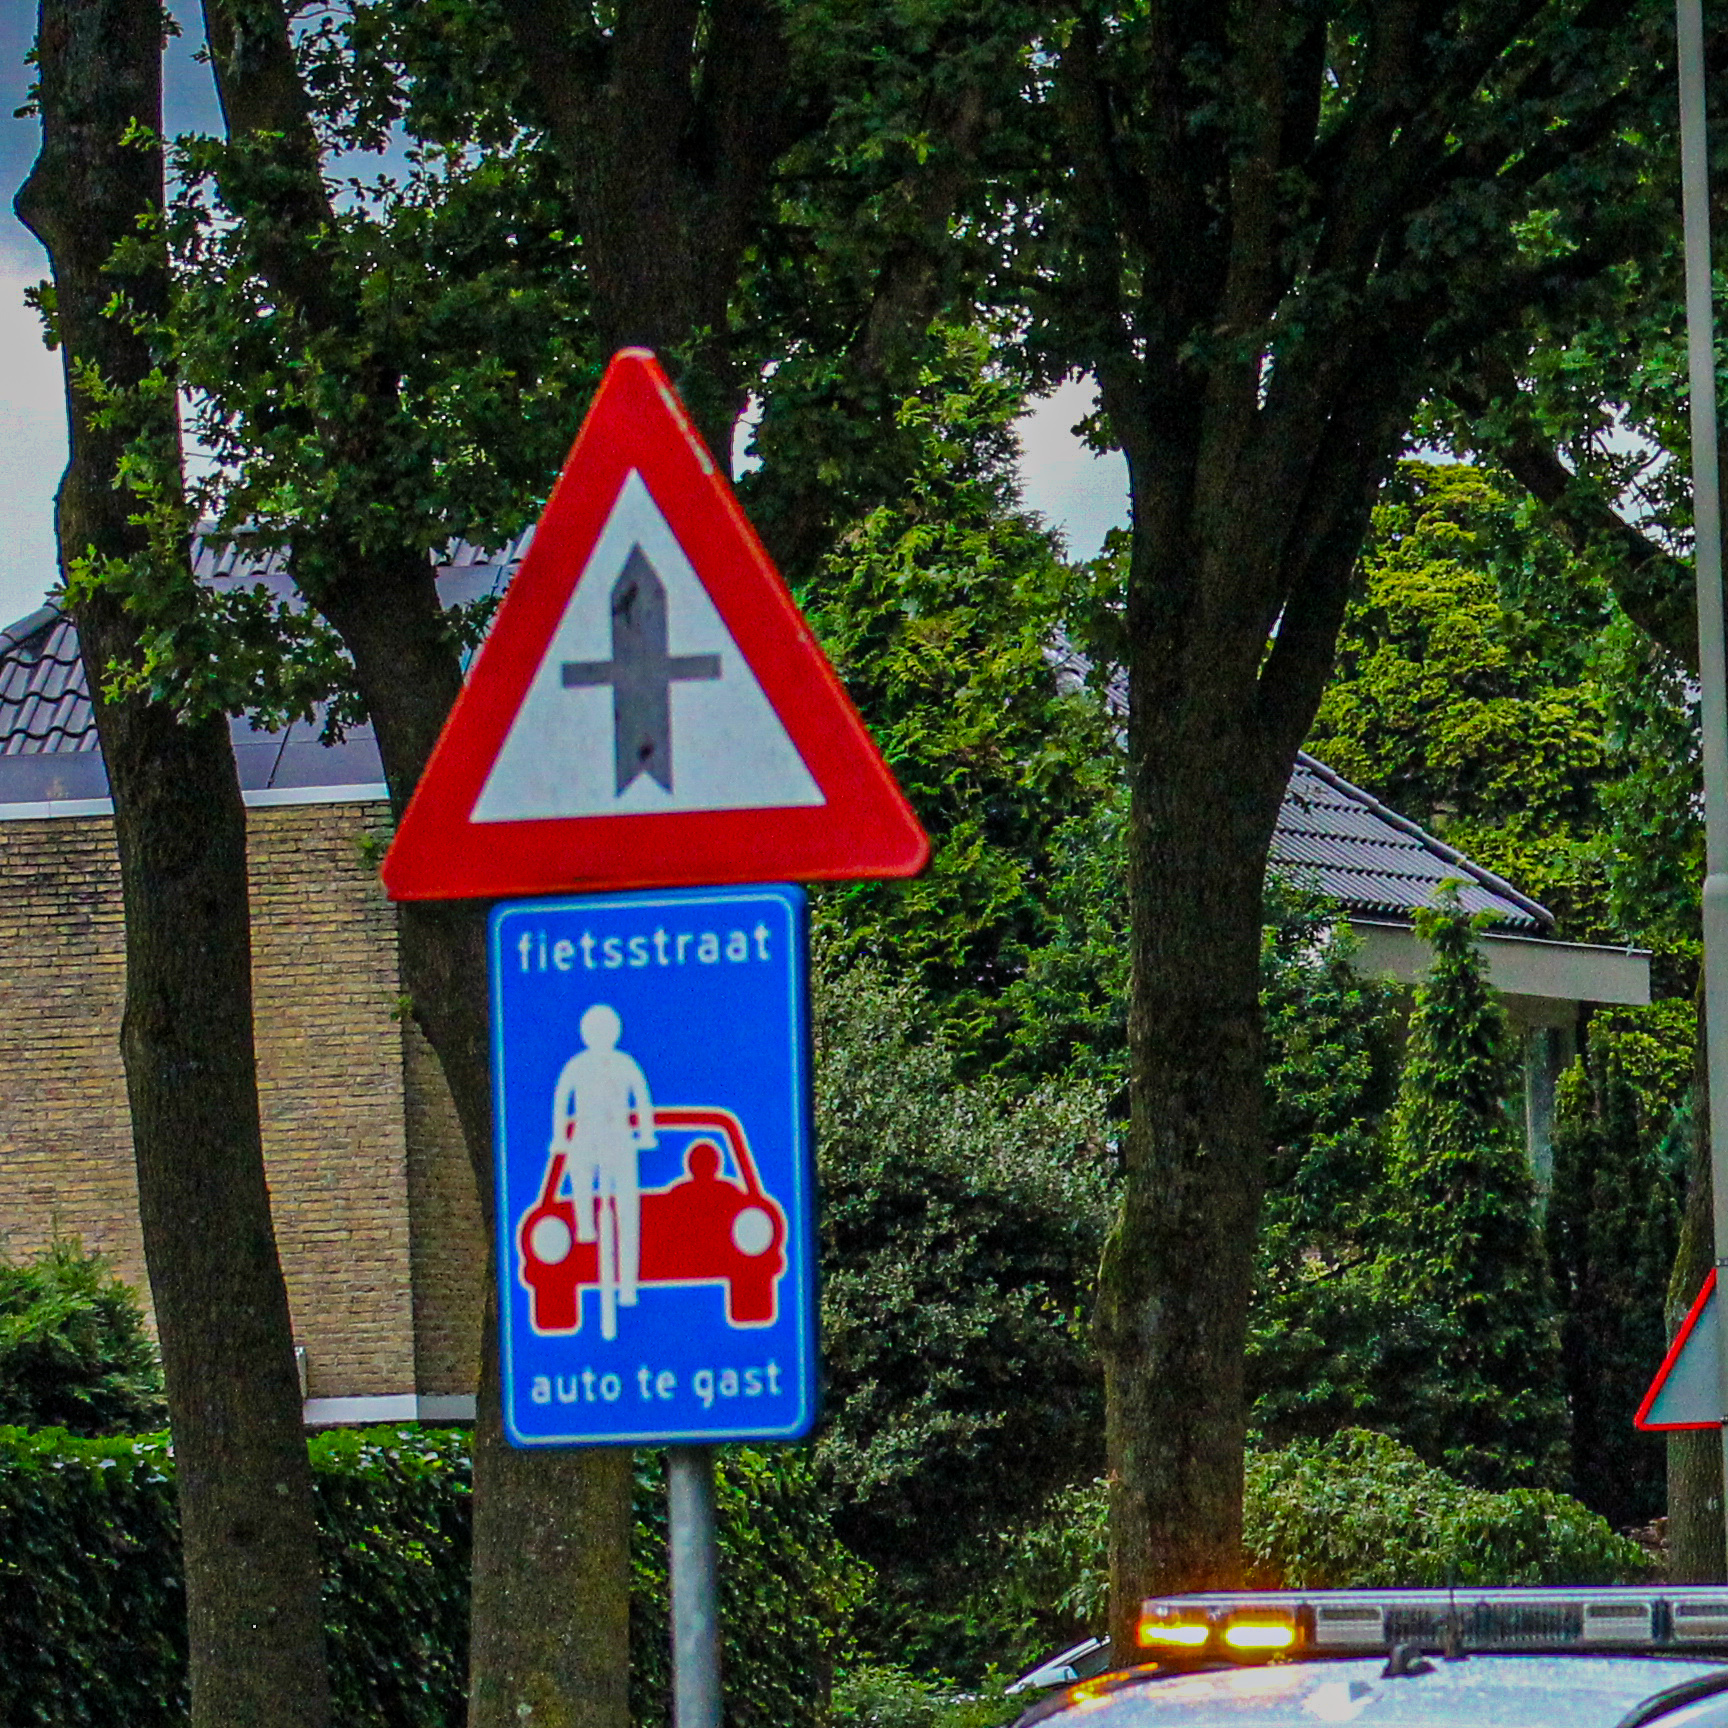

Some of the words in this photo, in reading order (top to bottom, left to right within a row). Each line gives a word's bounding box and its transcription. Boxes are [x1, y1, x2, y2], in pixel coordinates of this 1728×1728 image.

[517, 922, 772, 972] fietsstraat
[530, 1366, 622, 1405] auto
[638, 1364, 678, 1400] te
[692, 1361, 783, 1410] gast
